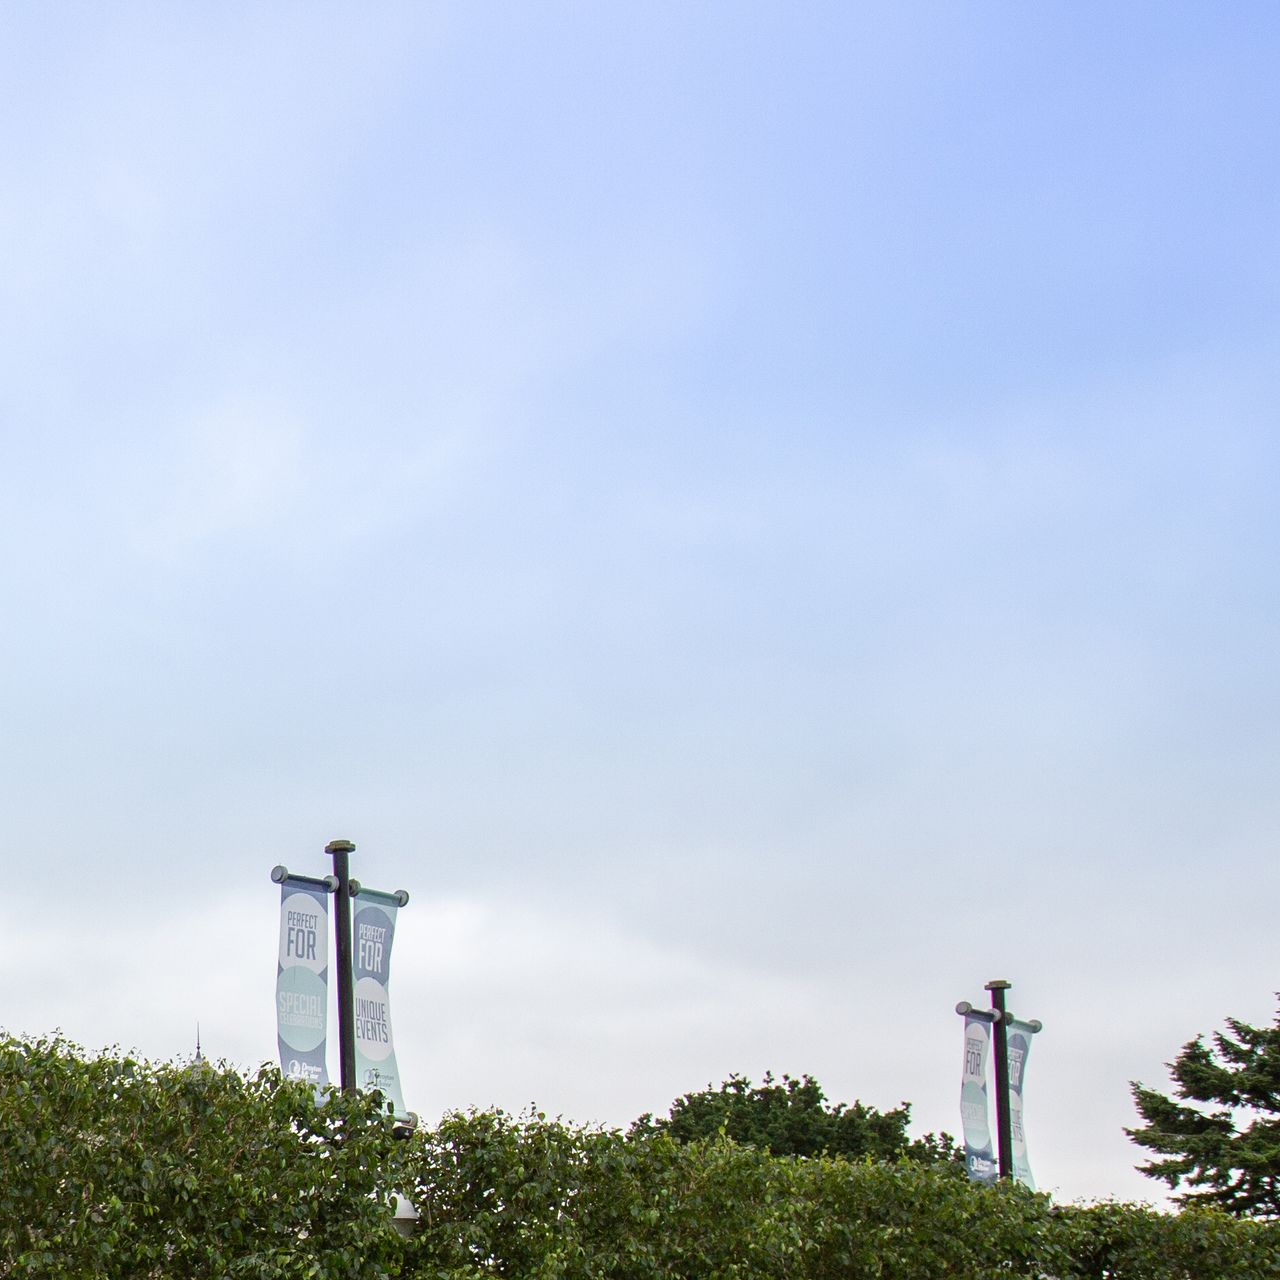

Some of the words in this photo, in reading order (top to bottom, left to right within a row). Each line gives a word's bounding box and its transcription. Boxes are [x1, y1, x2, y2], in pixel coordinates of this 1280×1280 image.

[287, 910, 318, 930] PERFECT
[287, 926, 316, 960] FOR
[359, 923, 386, 944] PERFECT
[359, 938, 383, 973] FOR
[279, 991, 323, 1018] SPECIAL
[355, 997, 386, 1023] UNIQUE
[356, 1018, 388, 1044] EVENTS
[965, 1050, 981, 1077] FOR
